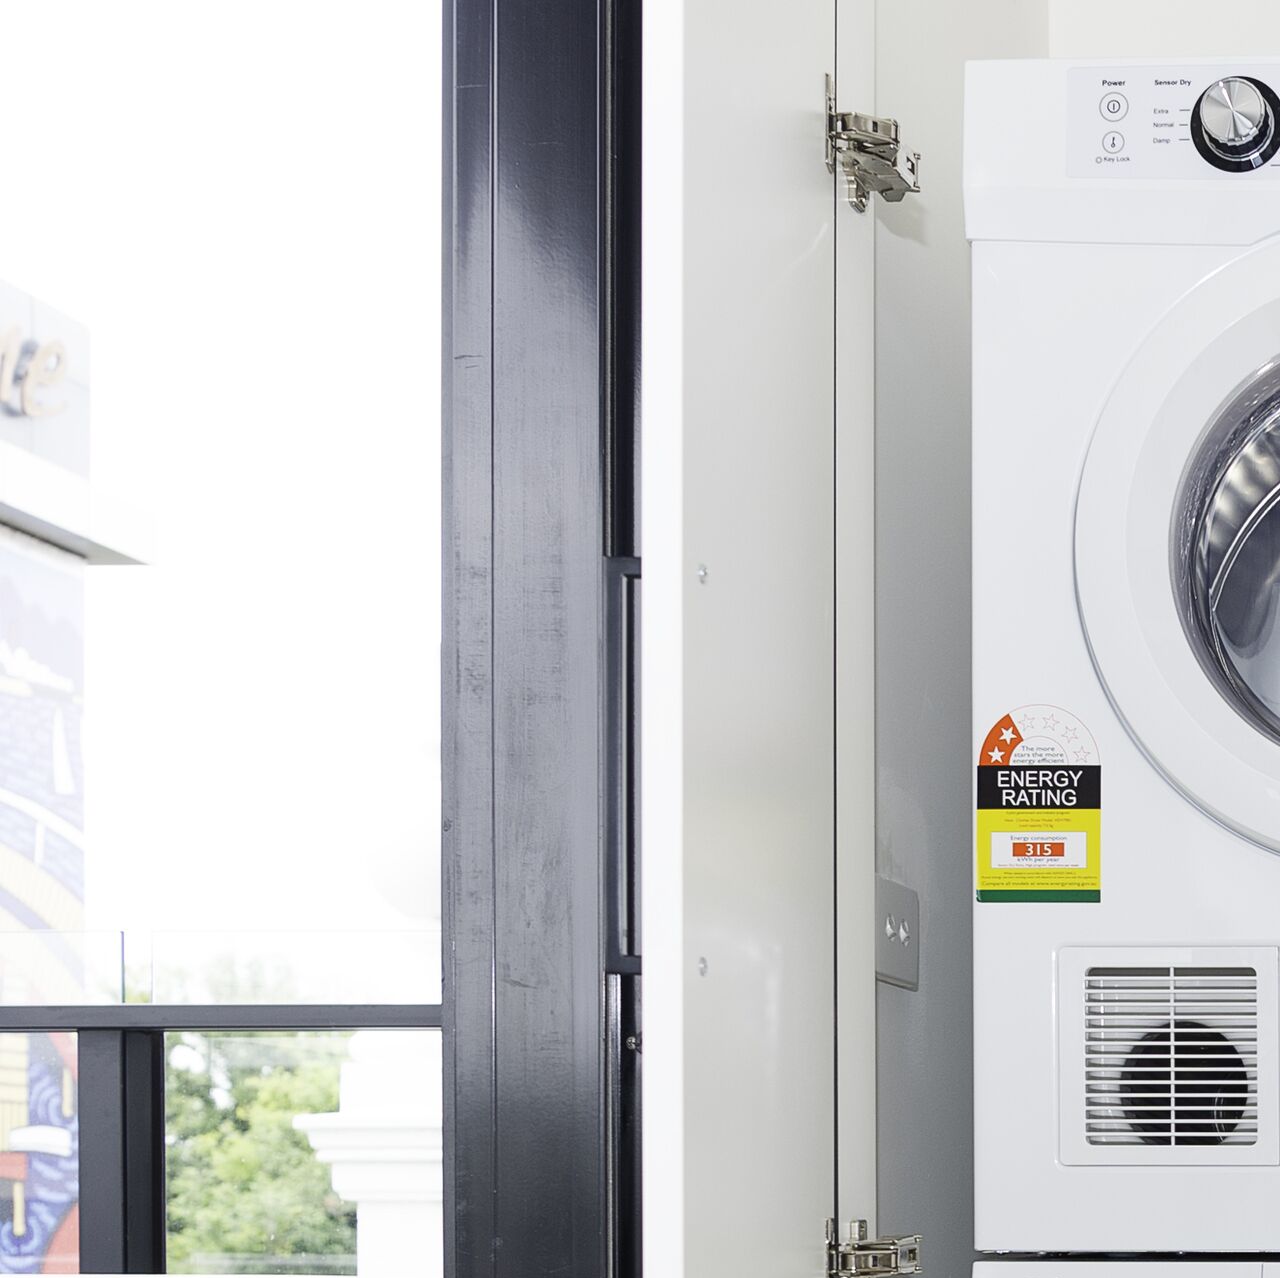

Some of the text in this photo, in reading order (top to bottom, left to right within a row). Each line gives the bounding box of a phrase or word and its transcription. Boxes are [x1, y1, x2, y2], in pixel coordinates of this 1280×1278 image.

[1180, 79, 1192, 87] Dry
[997, 770, 1083, 788] ENERGY
[1002, 789, 1077, 806] RATING
[1025, 843, 1052, 856] 315
